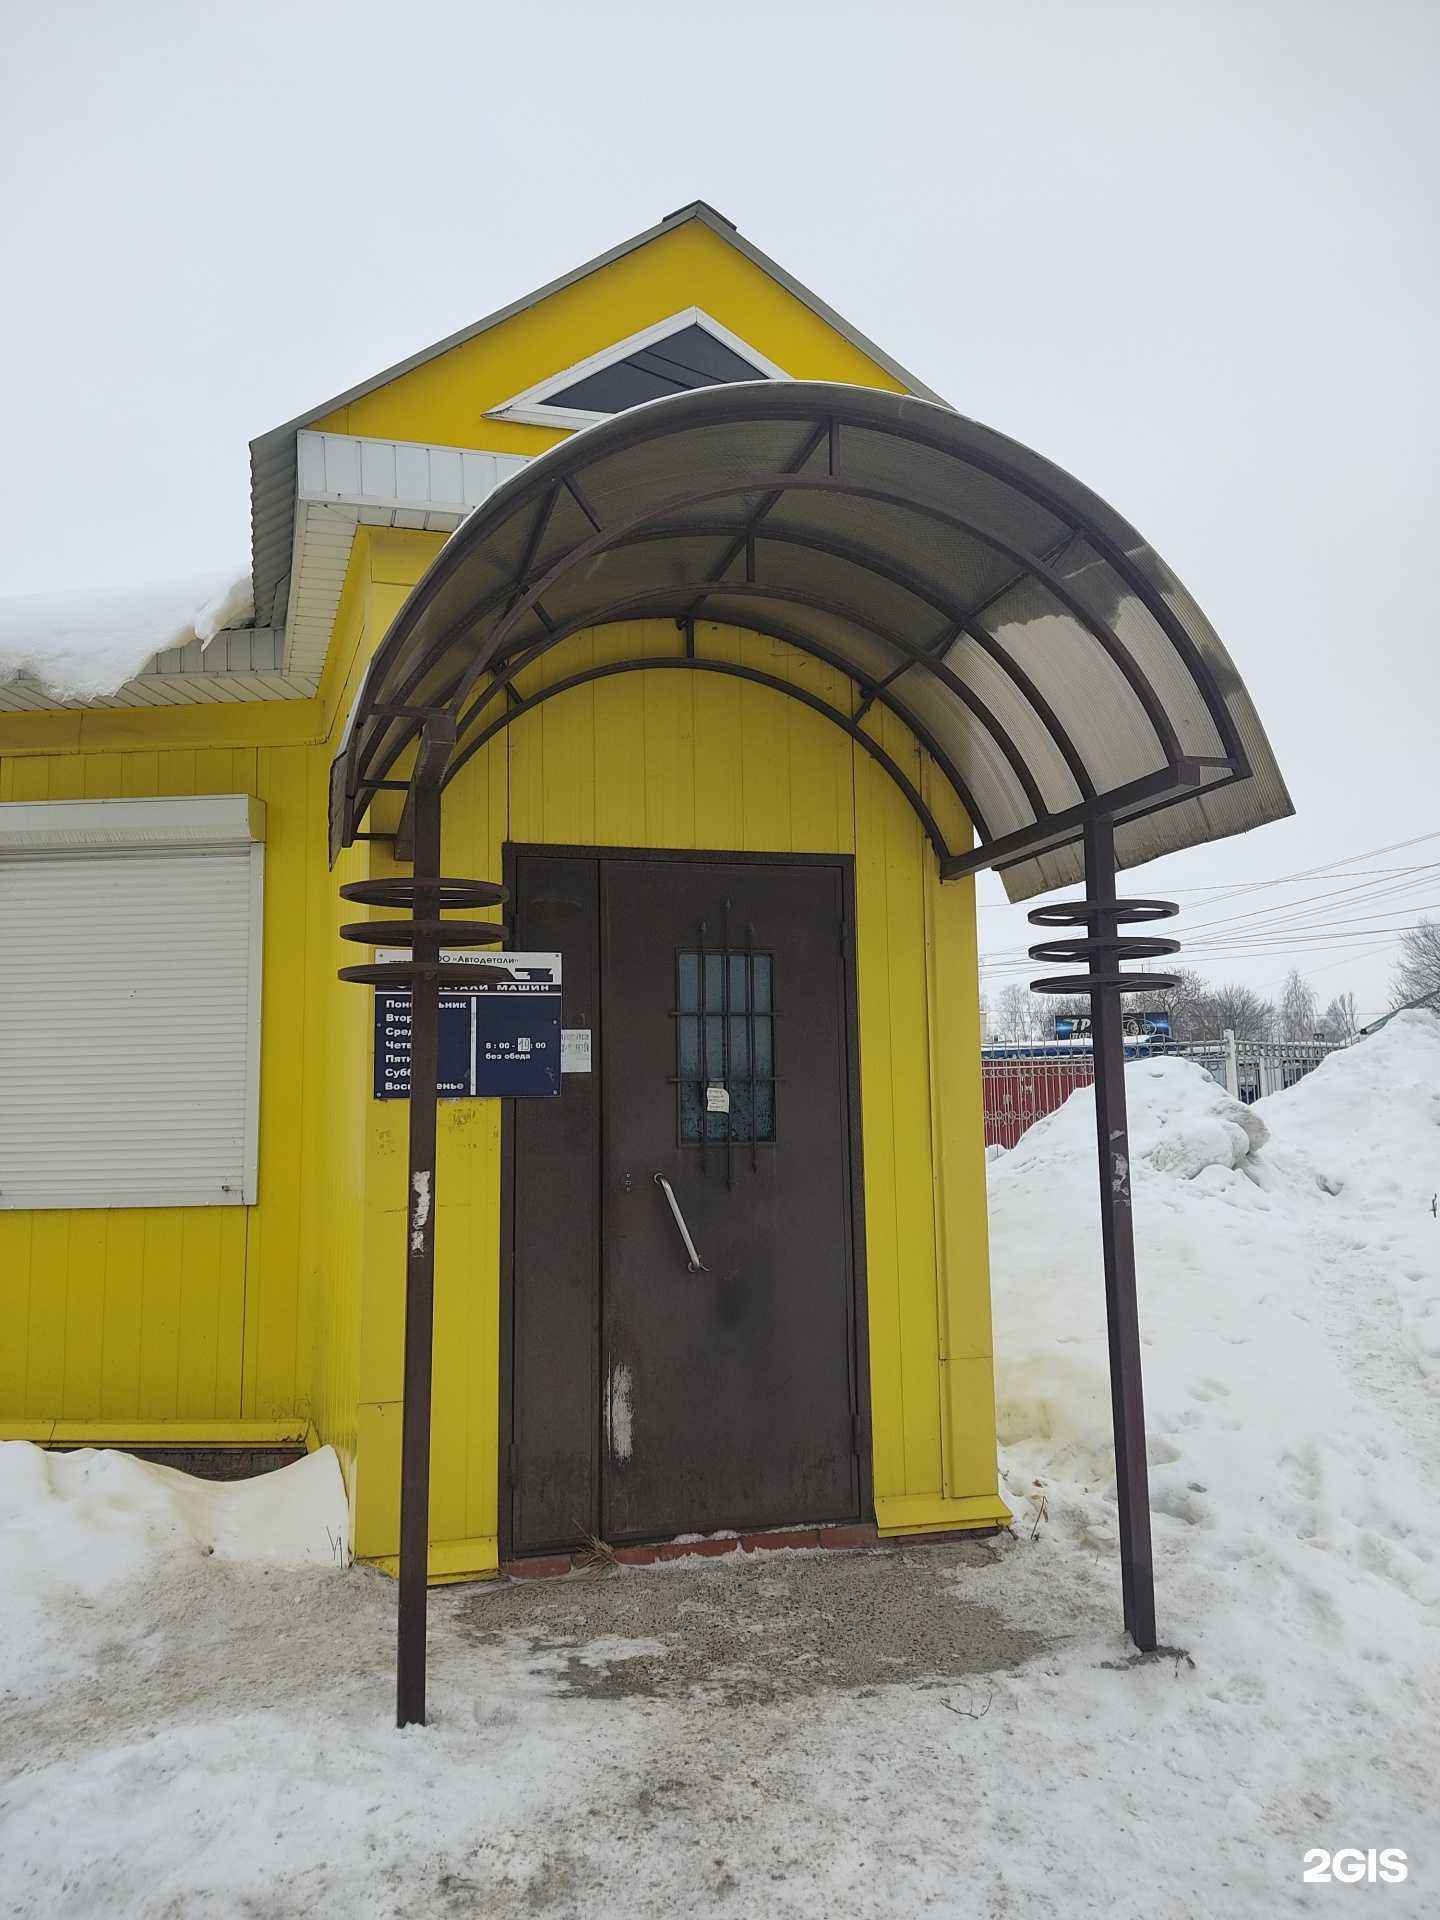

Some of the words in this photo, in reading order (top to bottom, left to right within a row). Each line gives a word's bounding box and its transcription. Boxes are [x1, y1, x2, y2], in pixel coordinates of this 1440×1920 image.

[386, 999, 467, 1009] Поньник
[385, 1013, 412, 1023] Втор
[385, 1040, 412, 1049] Четв
[385, 1054, 411, 1063] Пятн
[504, 1053, 531, 1061] обеда
